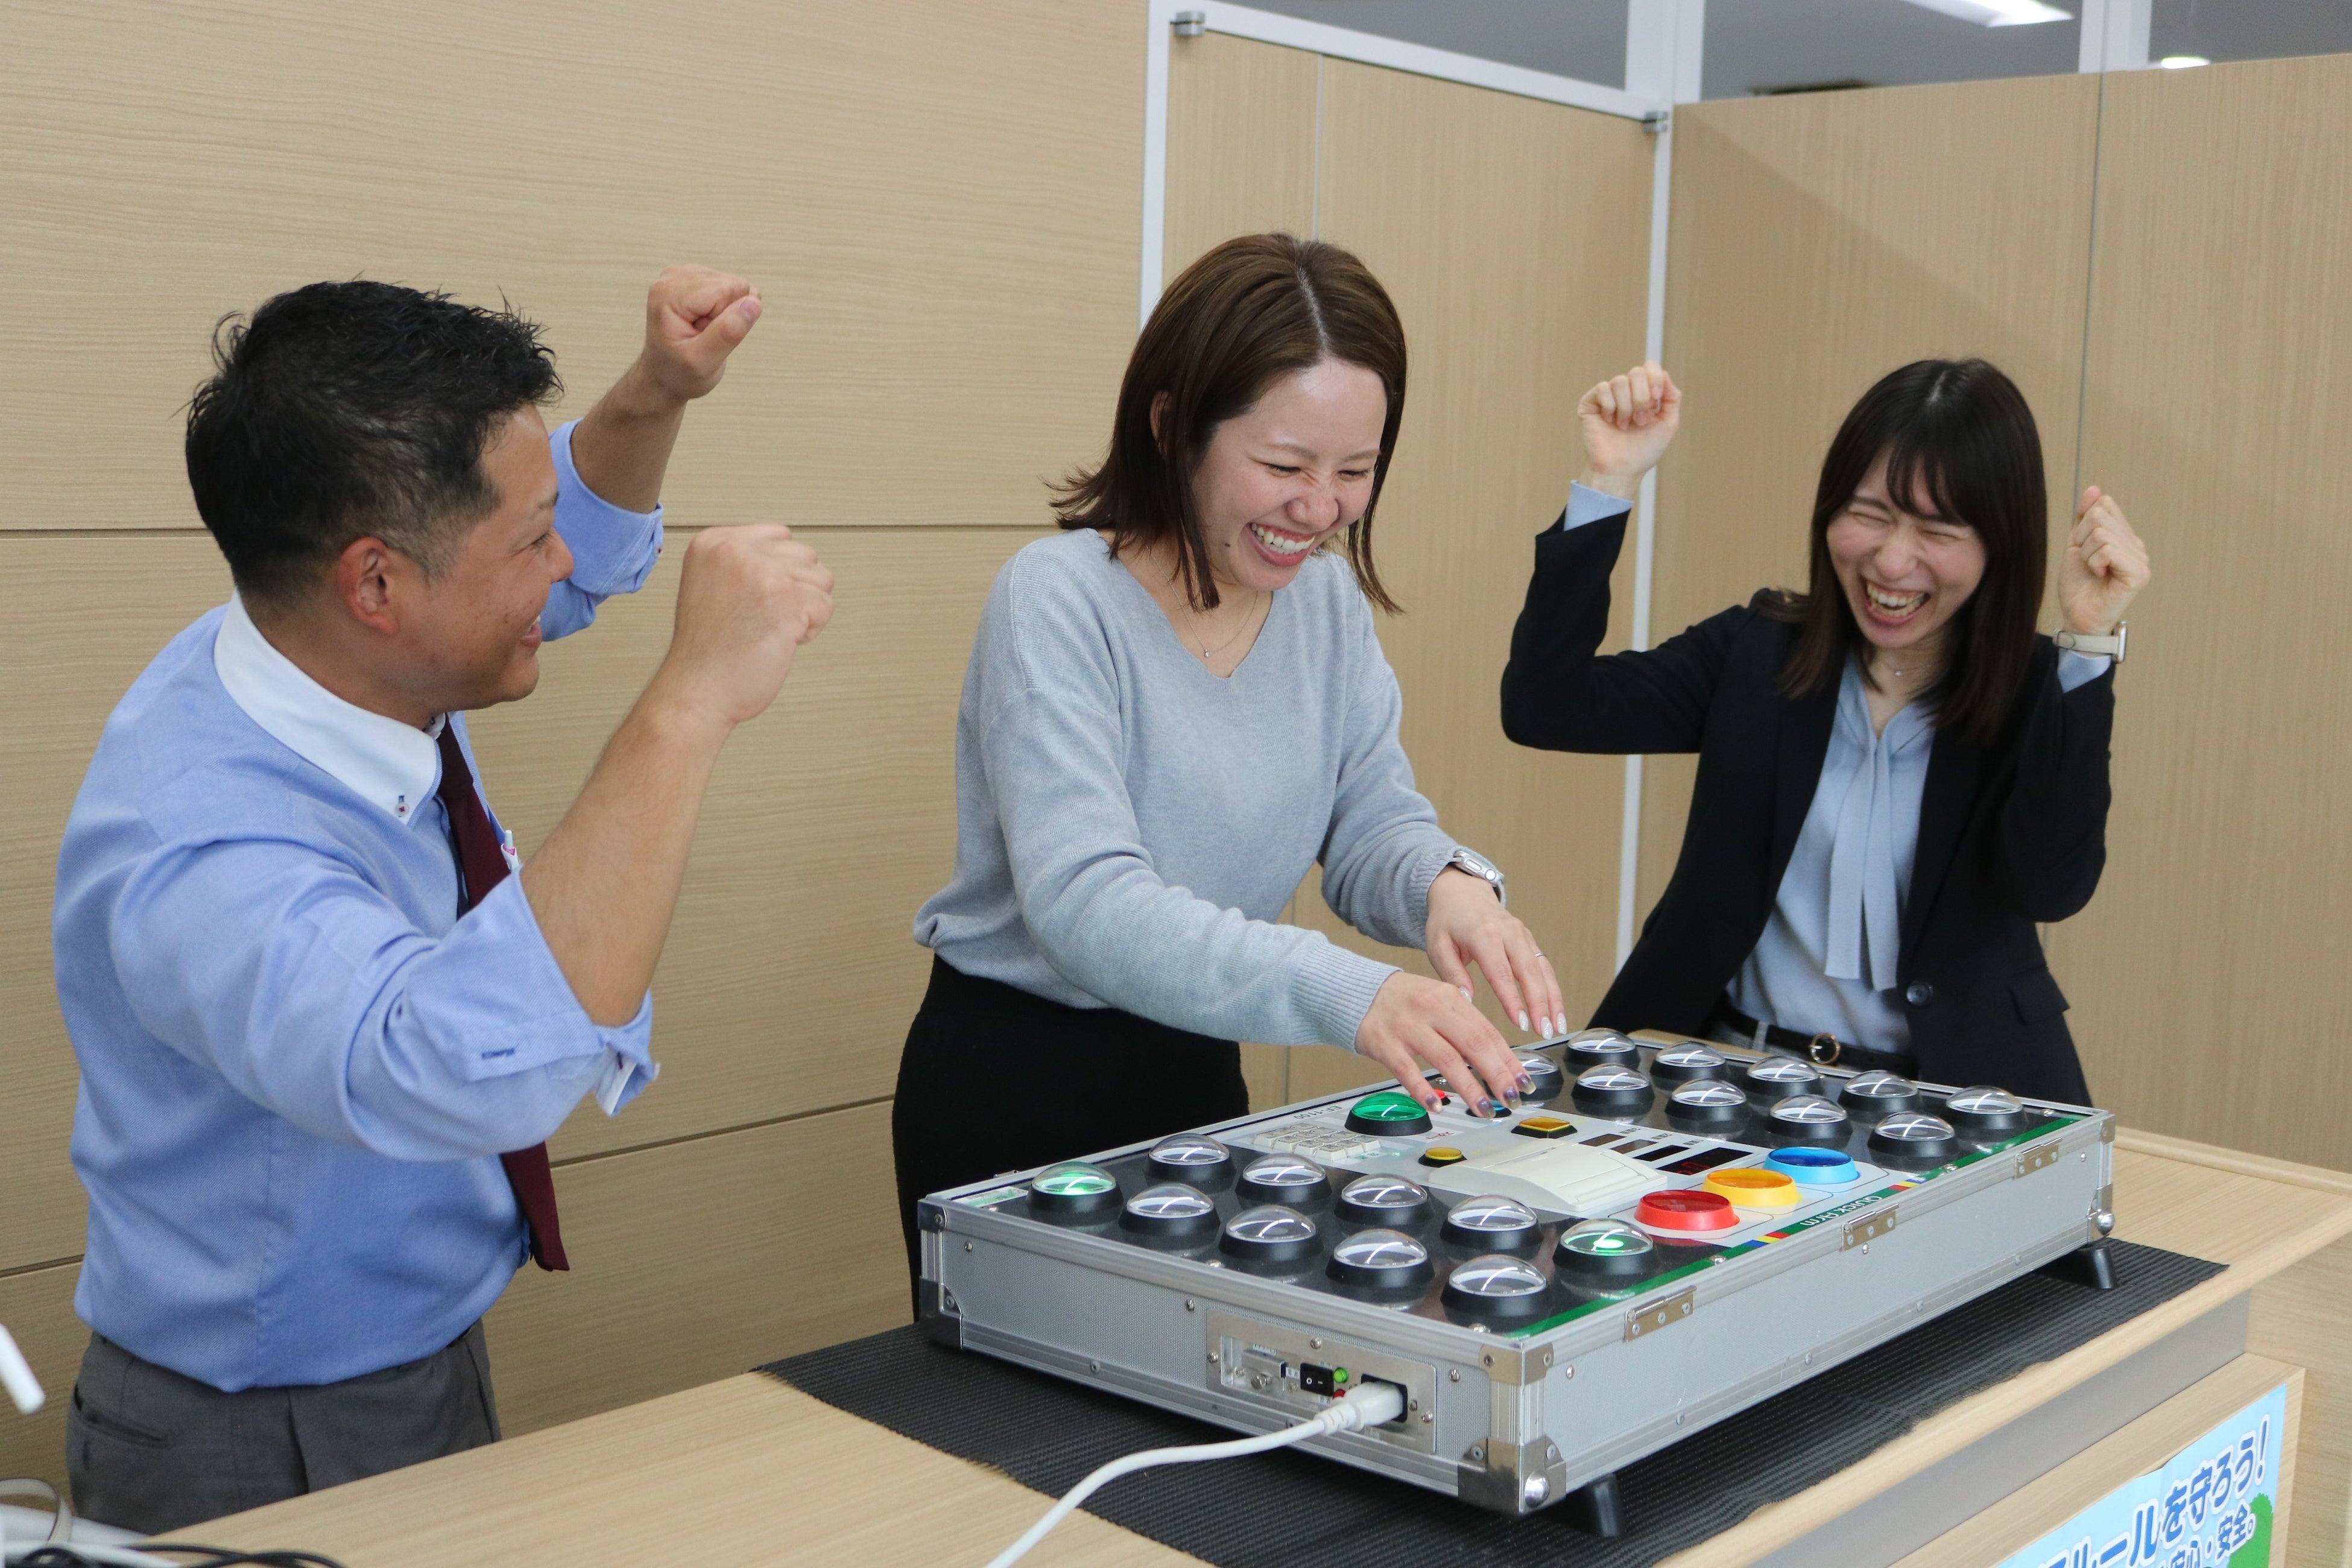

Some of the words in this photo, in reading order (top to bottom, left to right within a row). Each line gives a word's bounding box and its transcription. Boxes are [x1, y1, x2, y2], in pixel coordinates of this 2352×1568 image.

[1836, 1195, 1882, 1212] Quick
[1800, 1212, 1839, 1226] Arm
[2048, 1420, 2269, 1568] ルールを守ろう!
